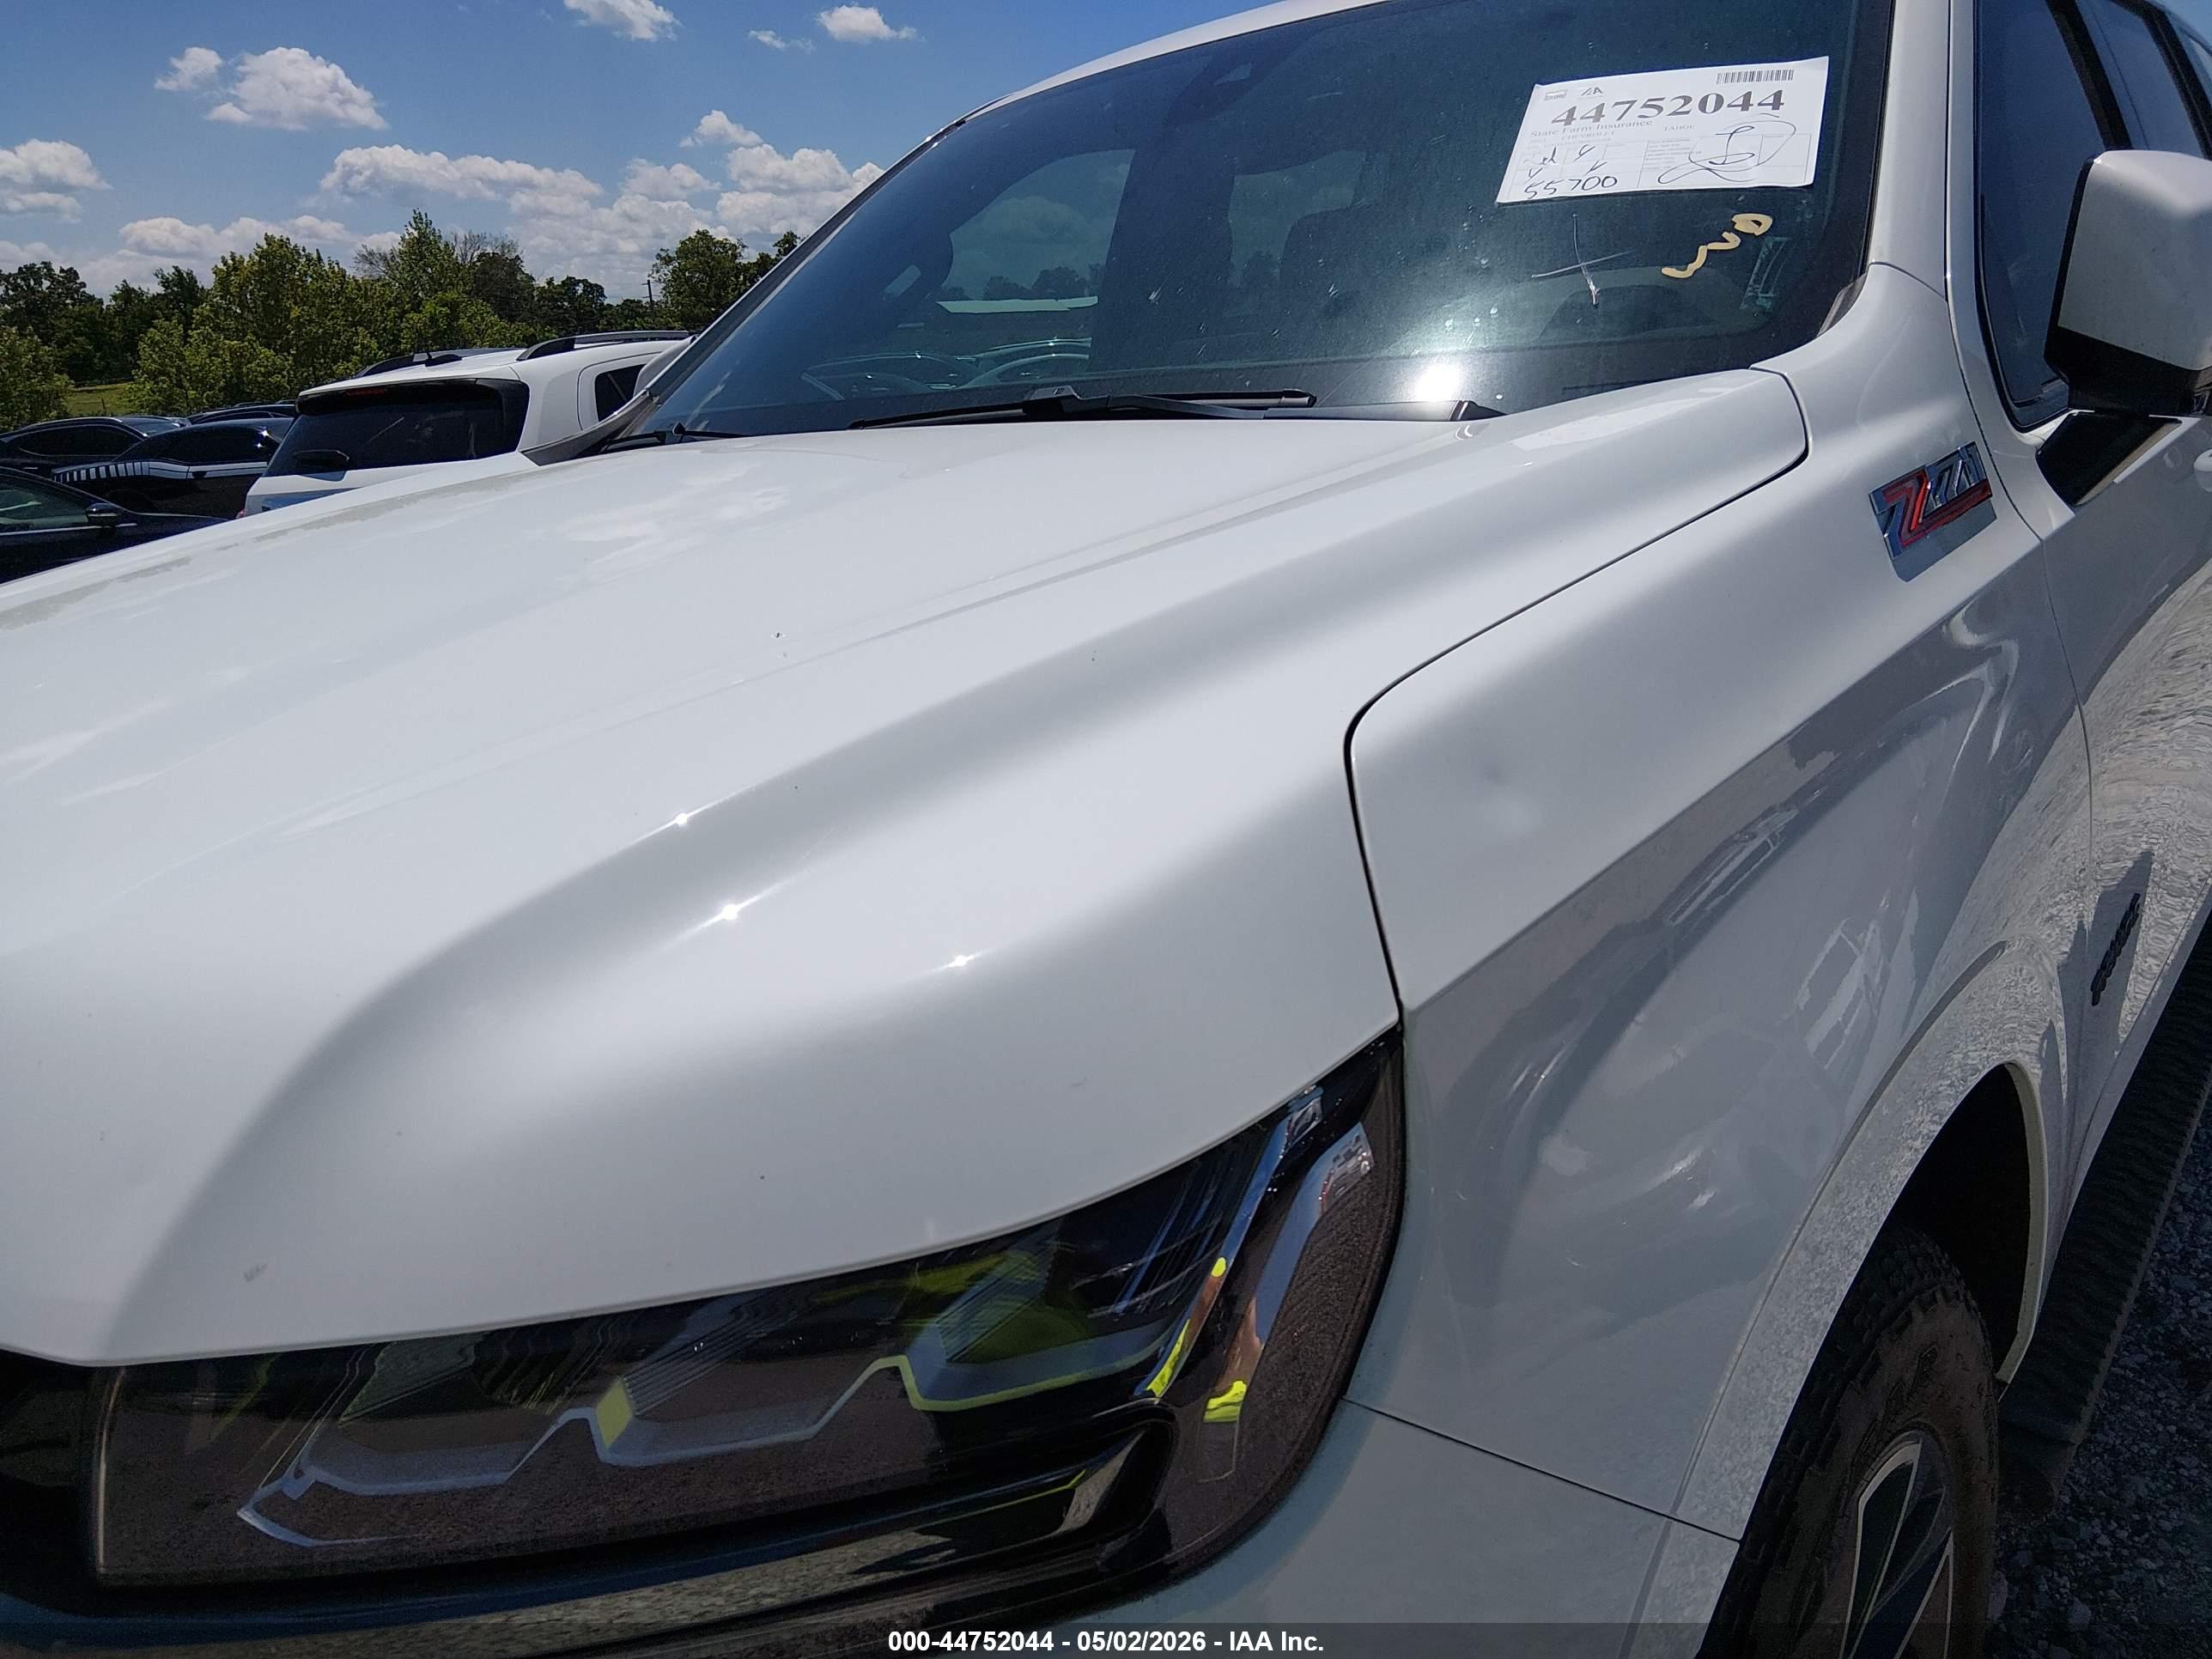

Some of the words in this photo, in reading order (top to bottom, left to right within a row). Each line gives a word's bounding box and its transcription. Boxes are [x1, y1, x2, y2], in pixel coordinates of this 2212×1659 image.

[1551, 89, 1785, 125] 44752044
[1531, 129, 1559, 137] State
[1562, 125, 1592, 134] Farm
[1596, 120, 1653, 132] Insurance
[1524, 175, 1618, 199] 55700
